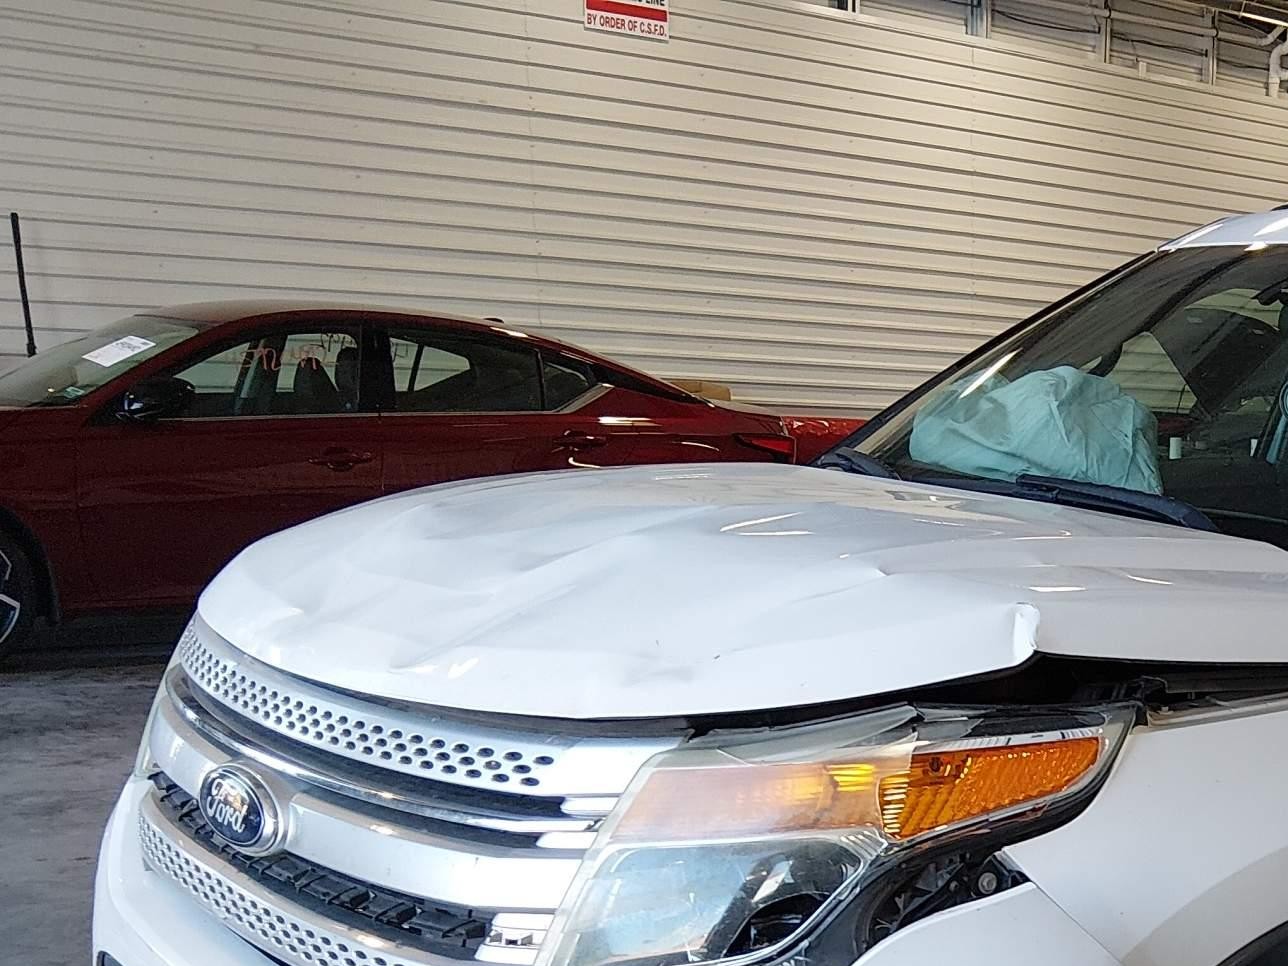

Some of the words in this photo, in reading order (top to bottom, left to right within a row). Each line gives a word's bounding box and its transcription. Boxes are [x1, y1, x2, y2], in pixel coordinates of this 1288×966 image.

[586, 13, 598, 26] BY
[600, 16, 626, 30] ORDER
[628, 20, 638, 32] OF
[207, 778, 249, 834] Ford
